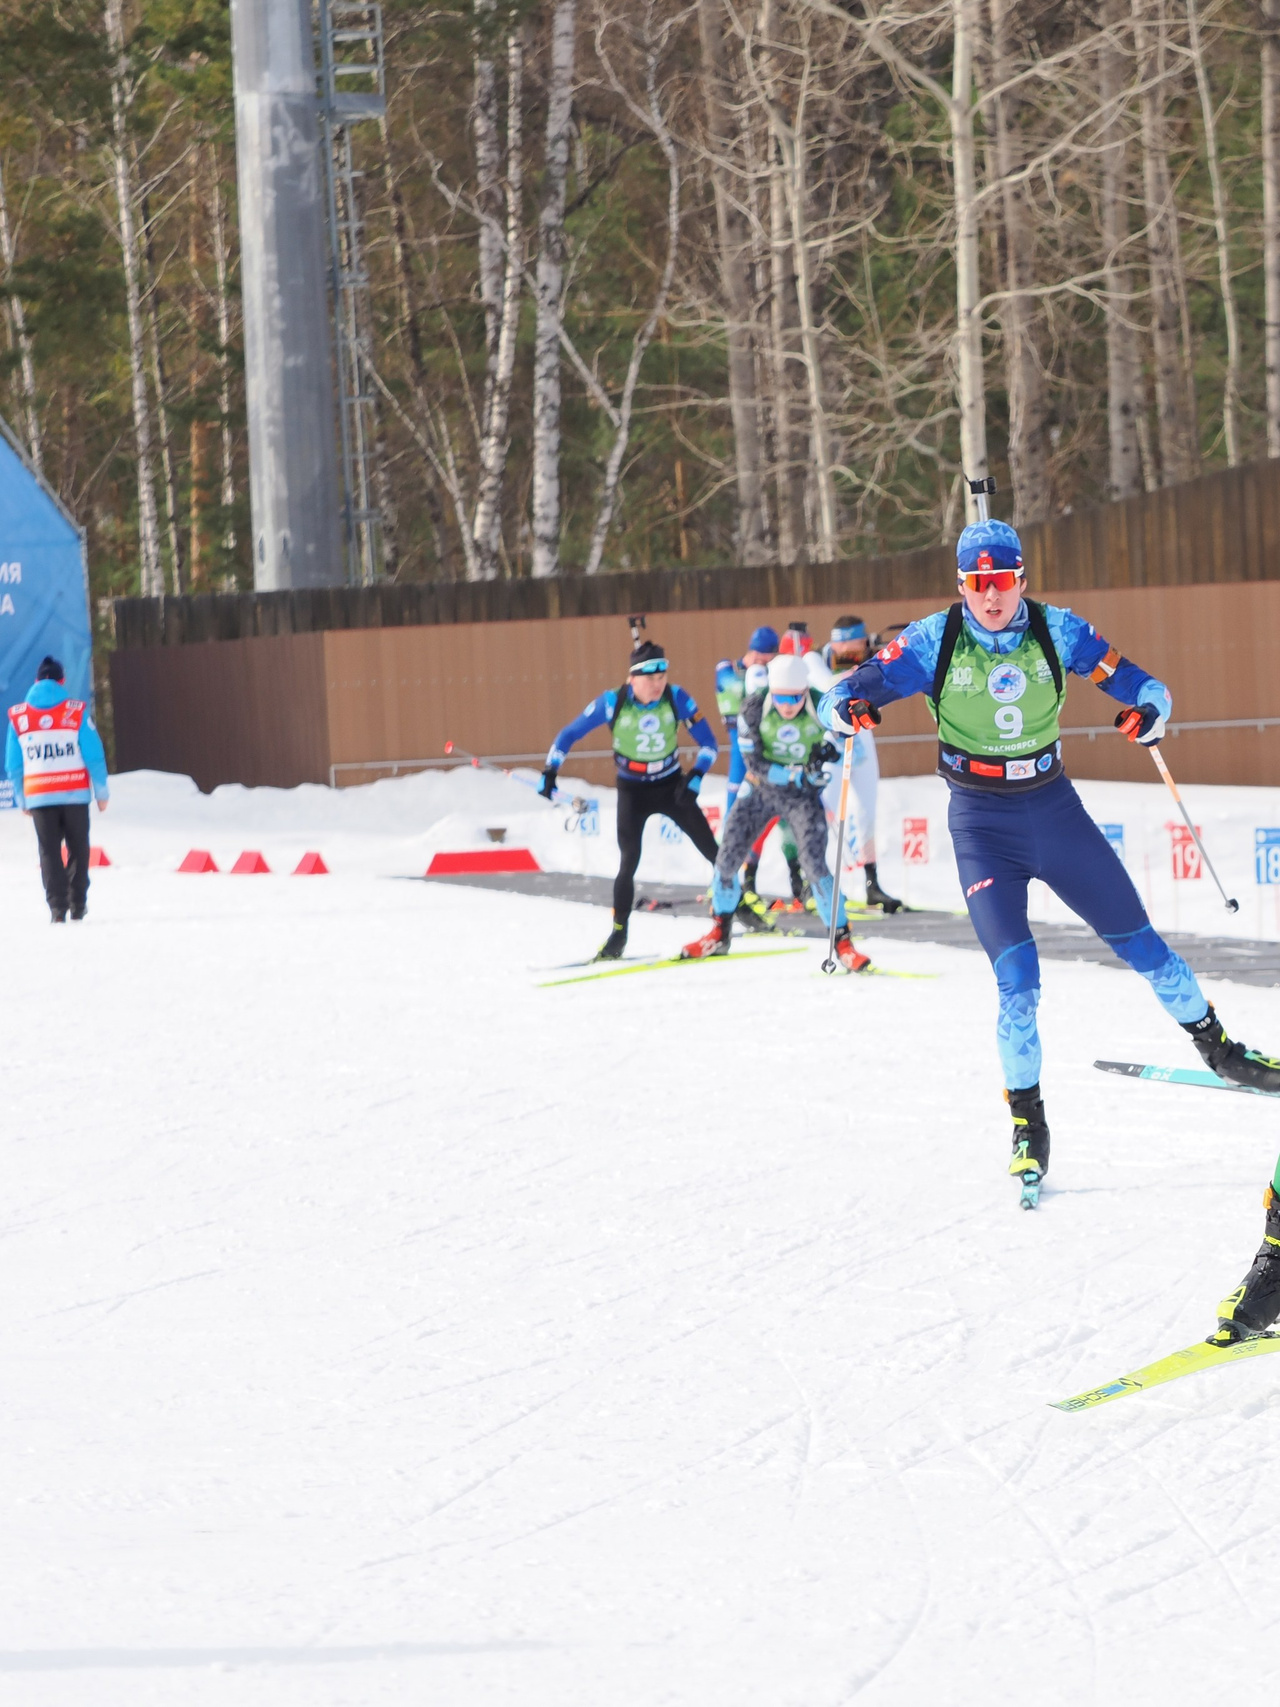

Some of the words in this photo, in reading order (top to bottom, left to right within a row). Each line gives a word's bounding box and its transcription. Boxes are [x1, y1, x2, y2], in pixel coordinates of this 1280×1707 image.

[994, 704, 1024, 739] 9
[26, 742, 75, 761] СУДЬЯ
[635, 733, 666, 753] 23
[904, 833, 928, 865] 23
[1172, 843, 1200, 878] 19
